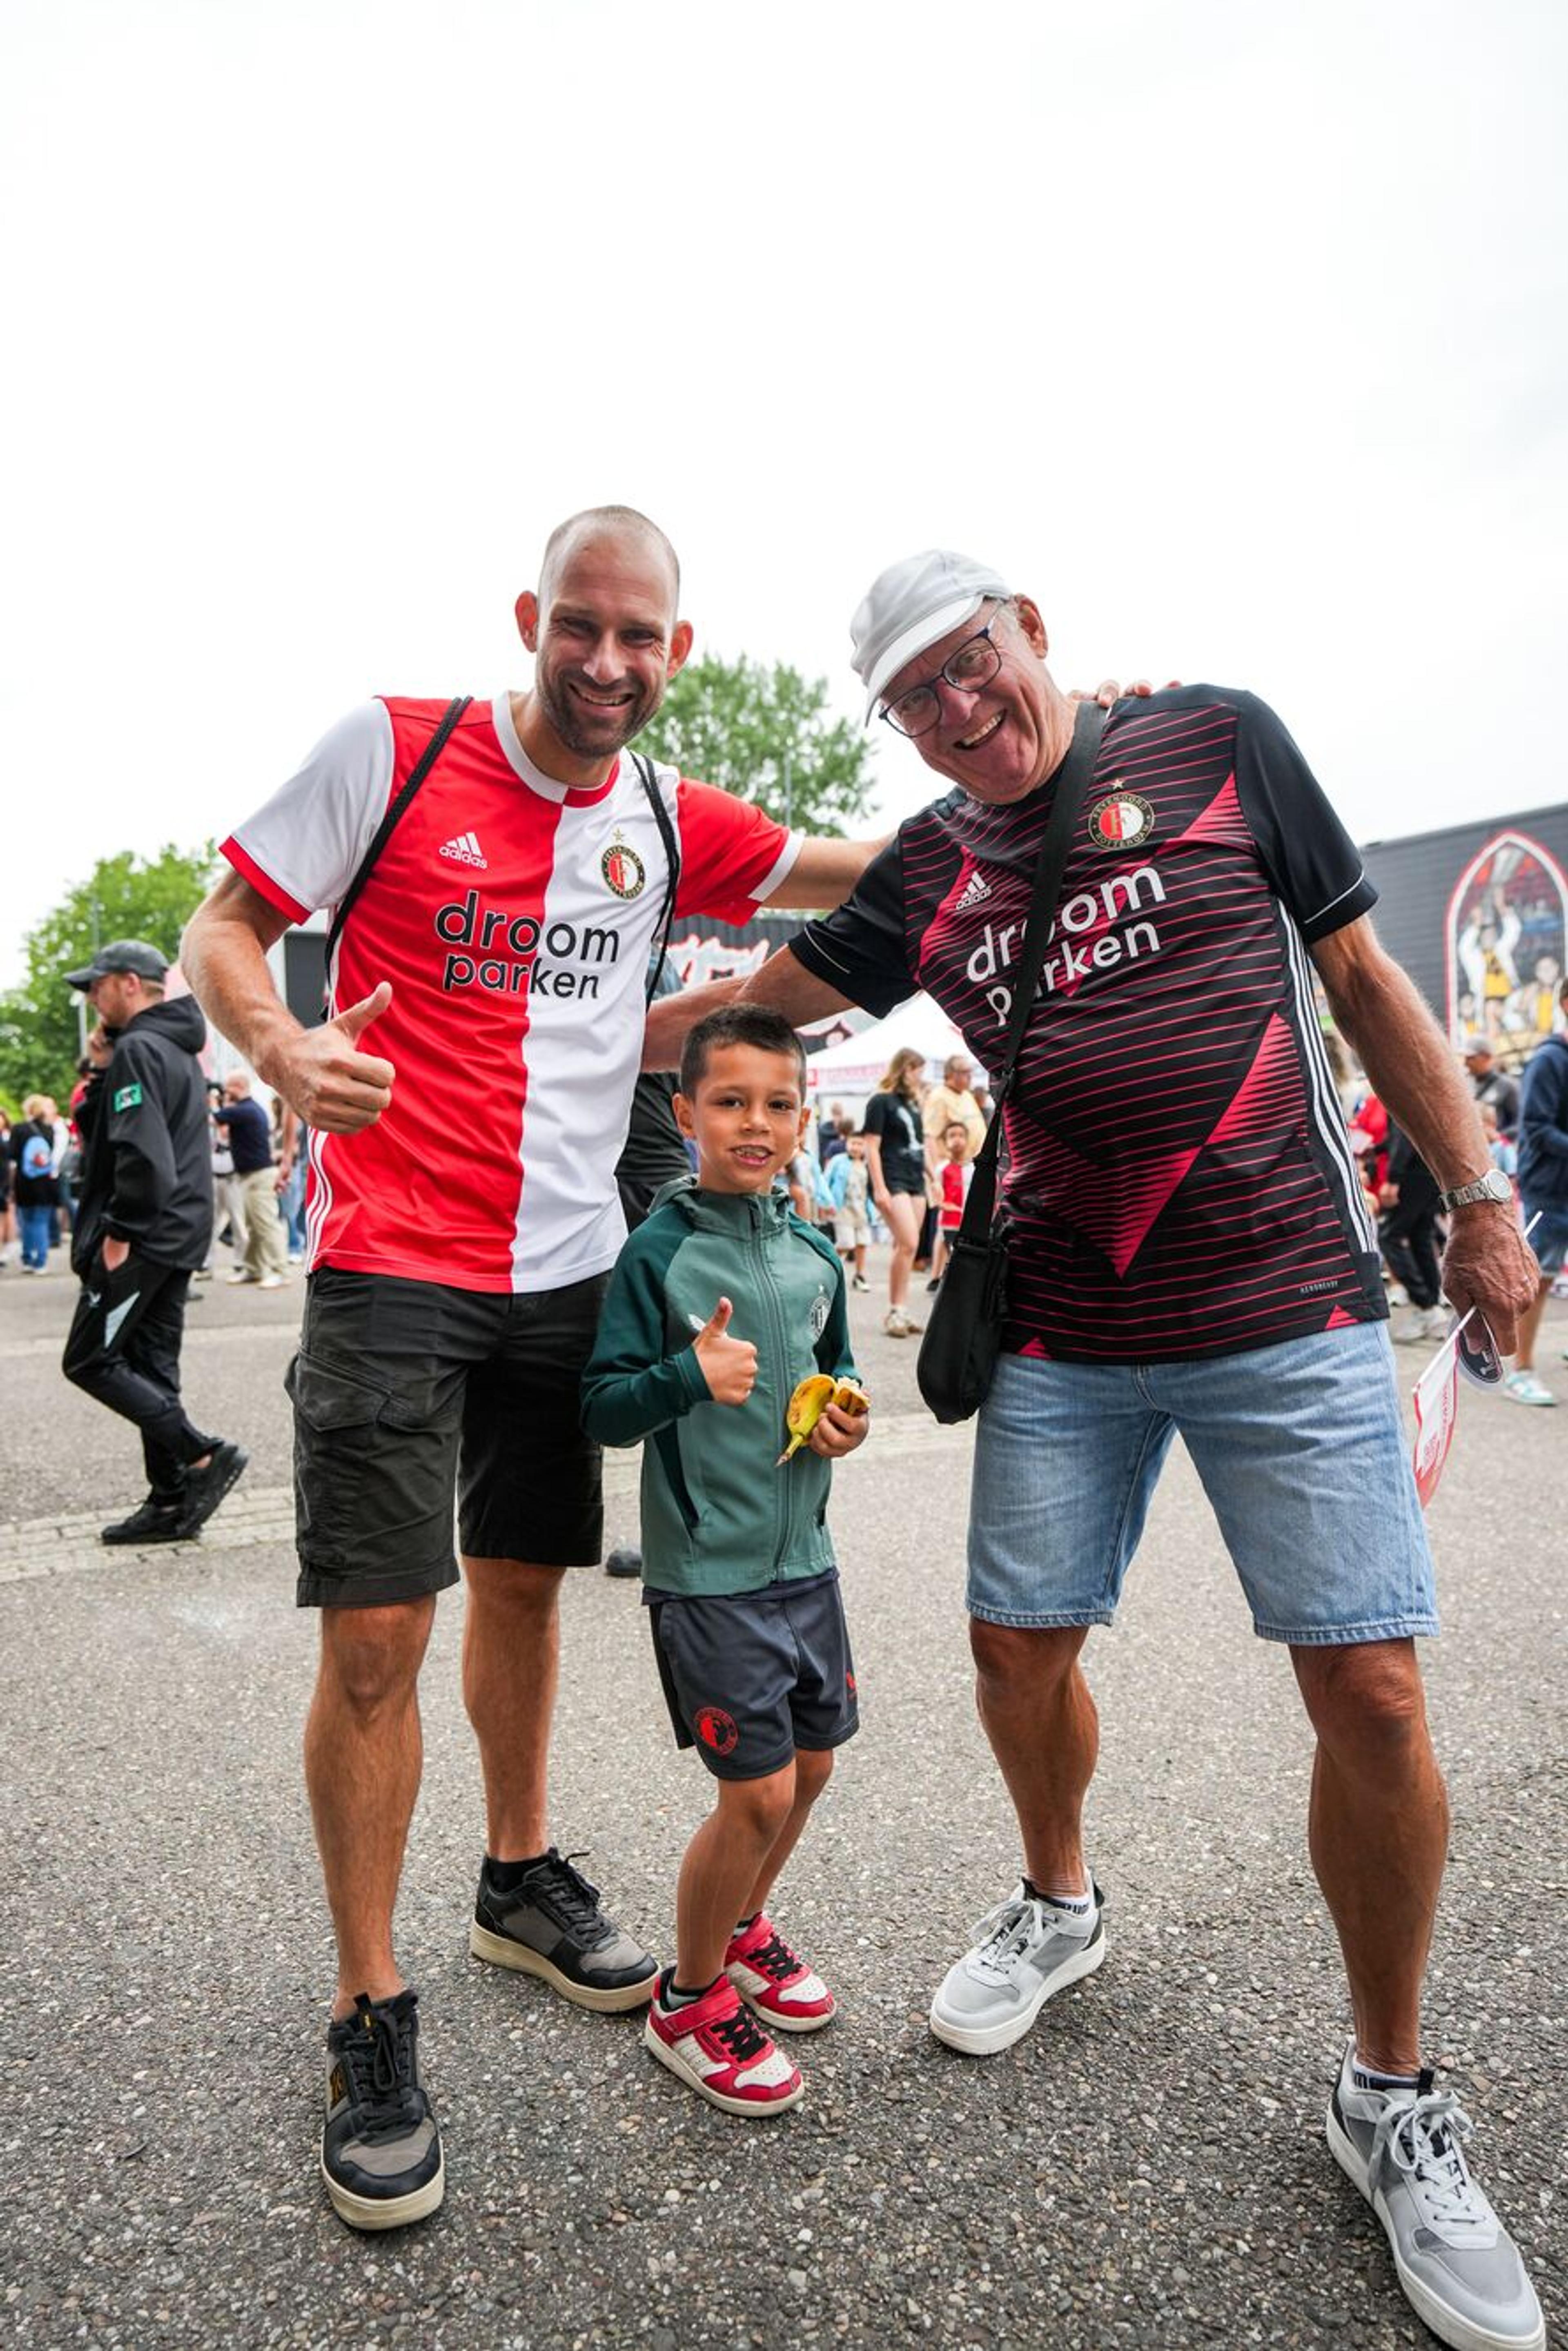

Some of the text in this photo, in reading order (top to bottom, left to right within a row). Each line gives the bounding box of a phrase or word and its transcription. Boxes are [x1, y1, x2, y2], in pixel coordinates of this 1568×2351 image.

[439, 846, 488, 869] adidas
[956, 886, 992, 910] adidas
[435, 889, 620, 962] droom
[443, 951, 599, 999] parken
[986, 922, 1160, 1027] prken
